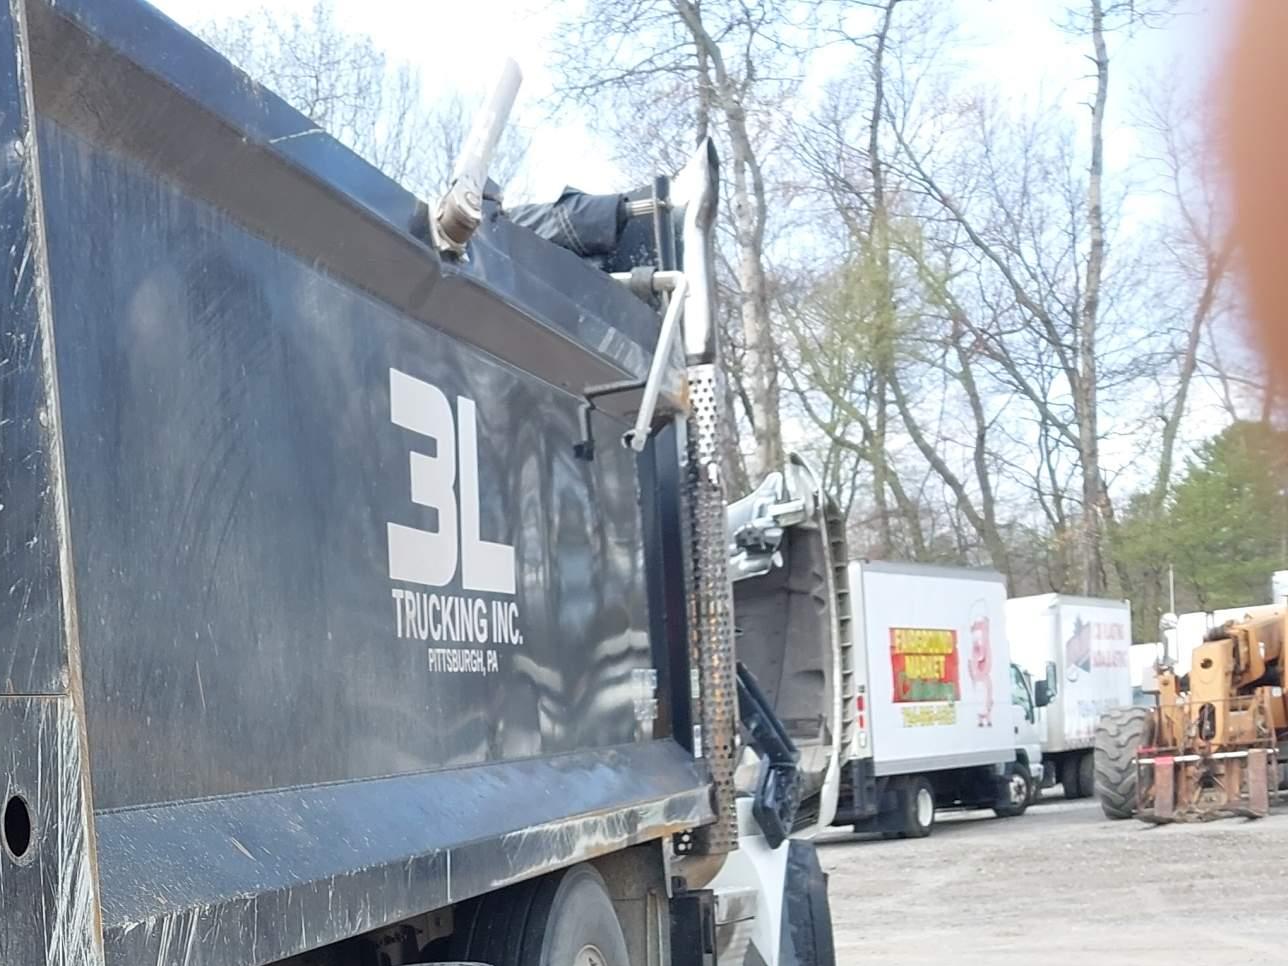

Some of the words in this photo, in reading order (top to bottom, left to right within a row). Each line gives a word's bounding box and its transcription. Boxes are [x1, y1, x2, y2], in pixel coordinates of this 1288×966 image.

[387, 368, 516, 595] 3L
[392, 588, 488, 643] TRUCKING
[492, 600, 523, 645] INC.
[428, 648, 486, 676] PITTSBURGH,
[487, 650, 499, 672] PA
